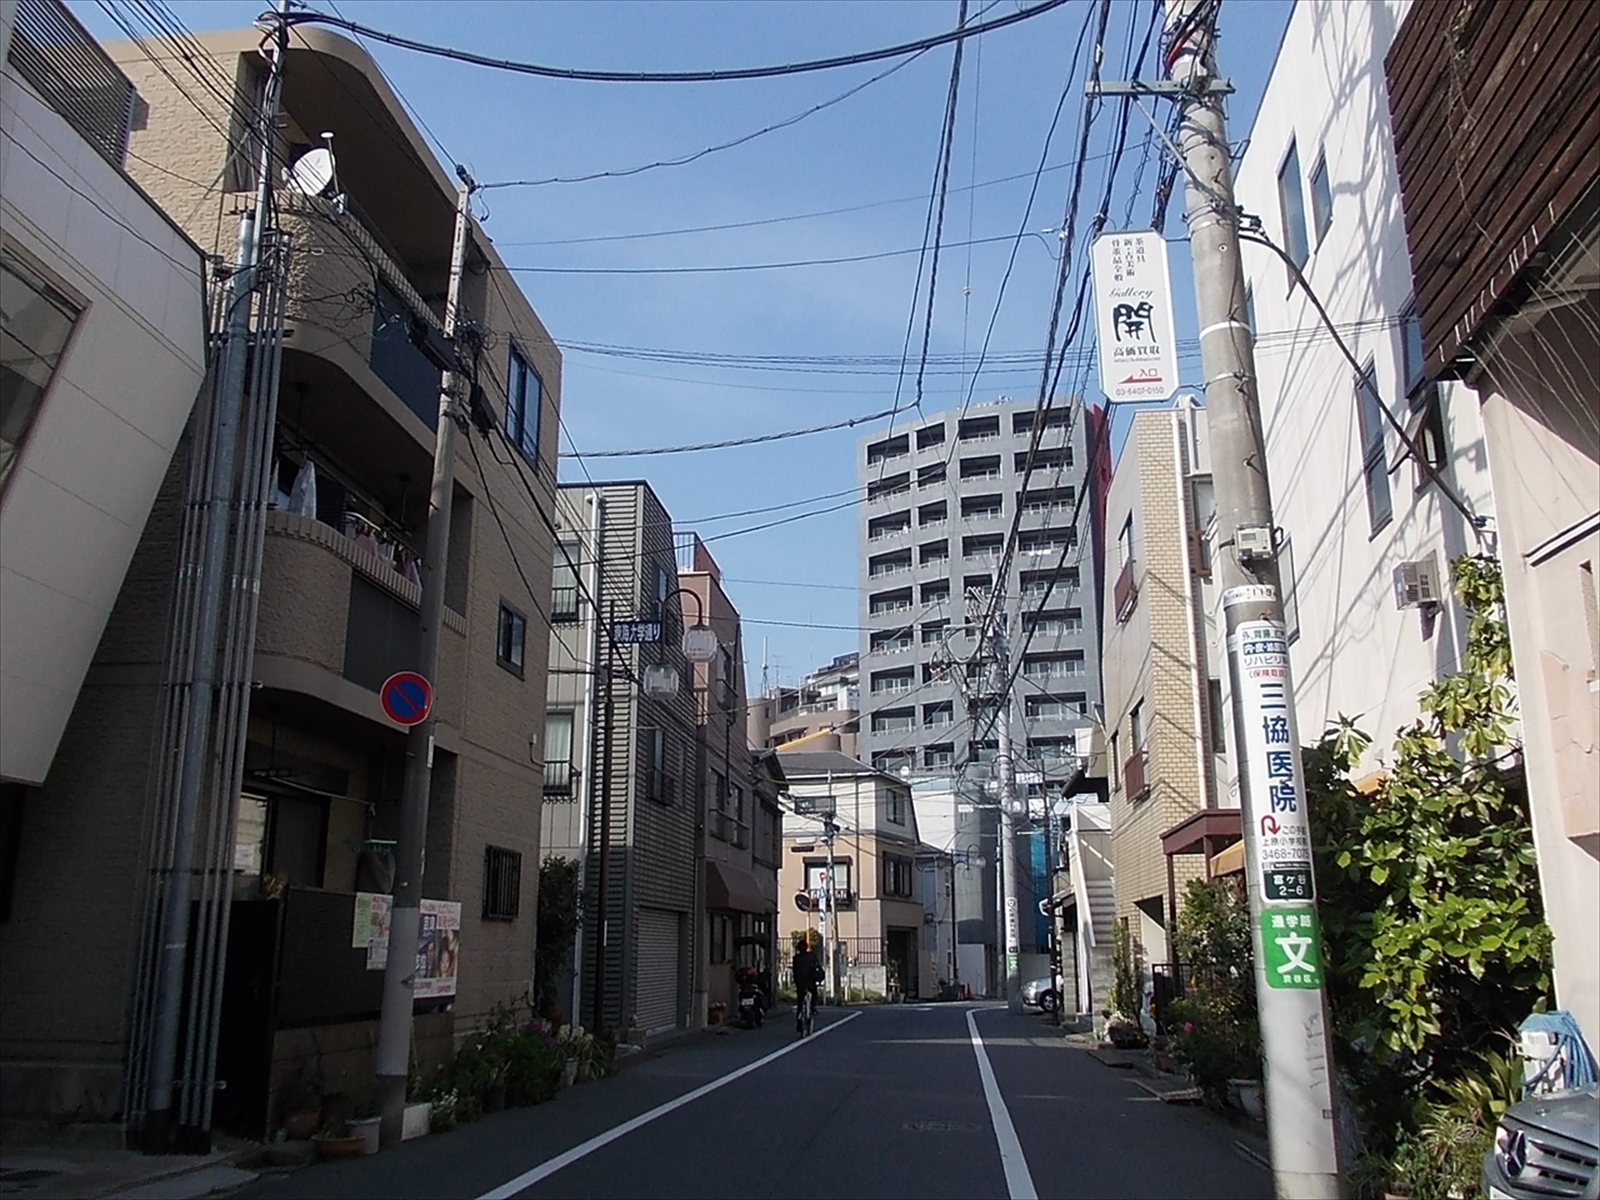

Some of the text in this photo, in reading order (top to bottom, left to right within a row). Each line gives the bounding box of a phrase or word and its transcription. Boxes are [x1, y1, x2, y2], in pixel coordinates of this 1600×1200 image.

[1135, 237, 1146, 263] 茶道具
[1109, 287, 1153, 299] Gallery
[1113, 345, 1160, 357] 高価買取
[1139, 368, 1158, 378] 入口
[613, 623, 661, 642] 東海大学通り
[1260, 683, 1297, 814] 三協医院
[1278, 885, 1304, 896] 2-6
[1271, 914, 1312, 929] 通学路
[1274, 931, 1315, 973] 文
